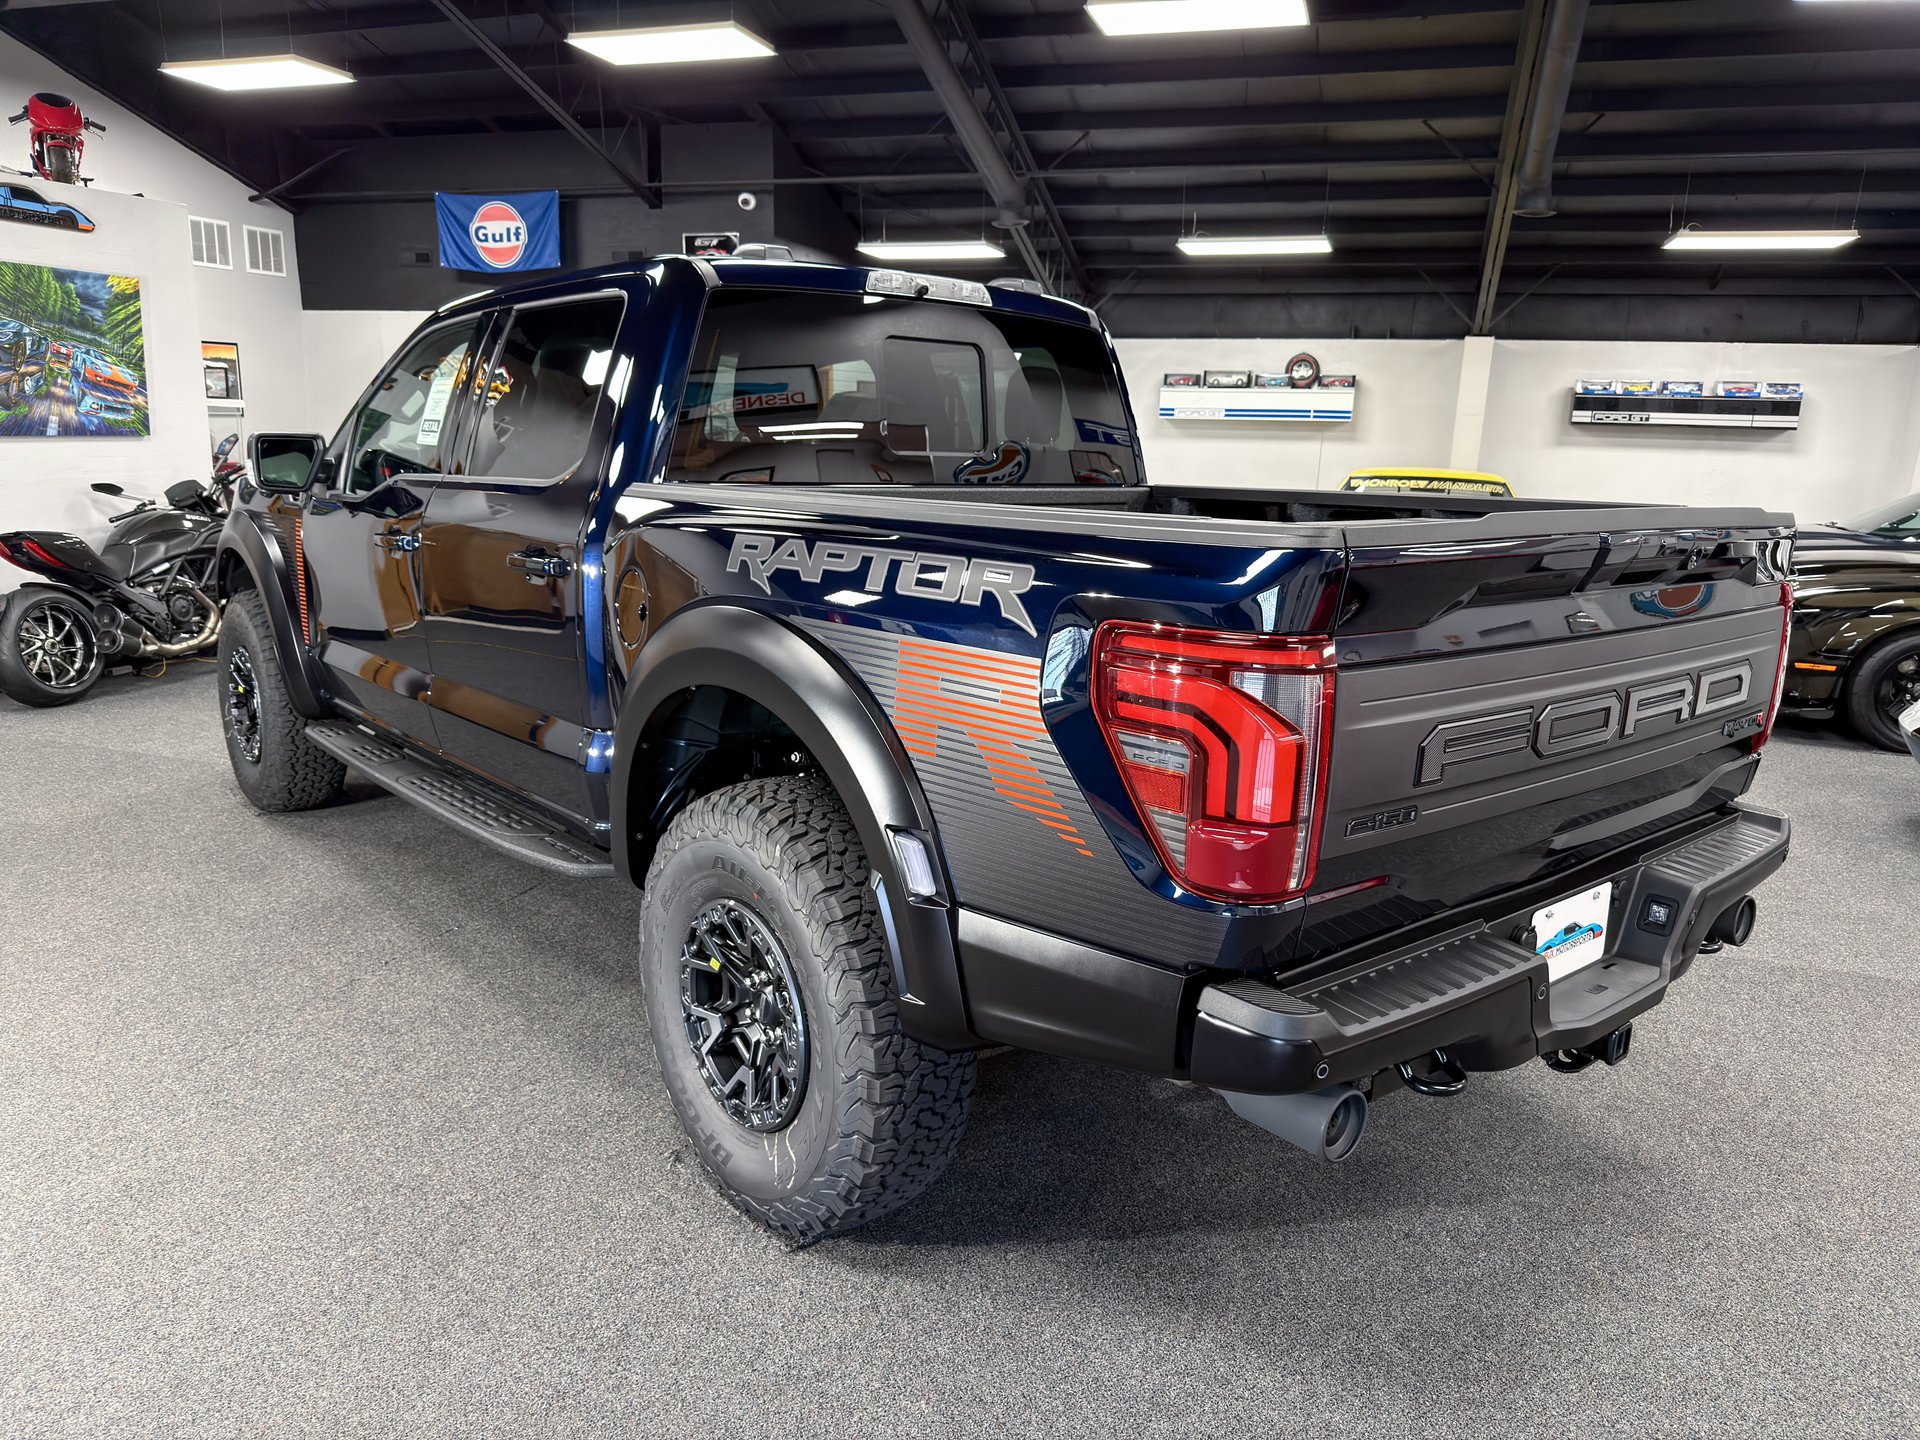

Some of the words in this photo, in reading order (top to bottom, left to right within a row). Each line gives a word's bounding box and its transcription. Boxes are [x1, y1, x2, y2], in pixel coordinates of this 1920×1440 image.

[474, 225, 523, 243] Gulf
[1593, 412, 1629, 422] FORD
[1630, 413, 1650, 422] GT
[185, 513, 212, 522] DUCATI
[726, 533, 1038, 638] RAPTOR
[1413, 659, 1753, 788] FORD
[1132, 753, 1185, 770] FORD
